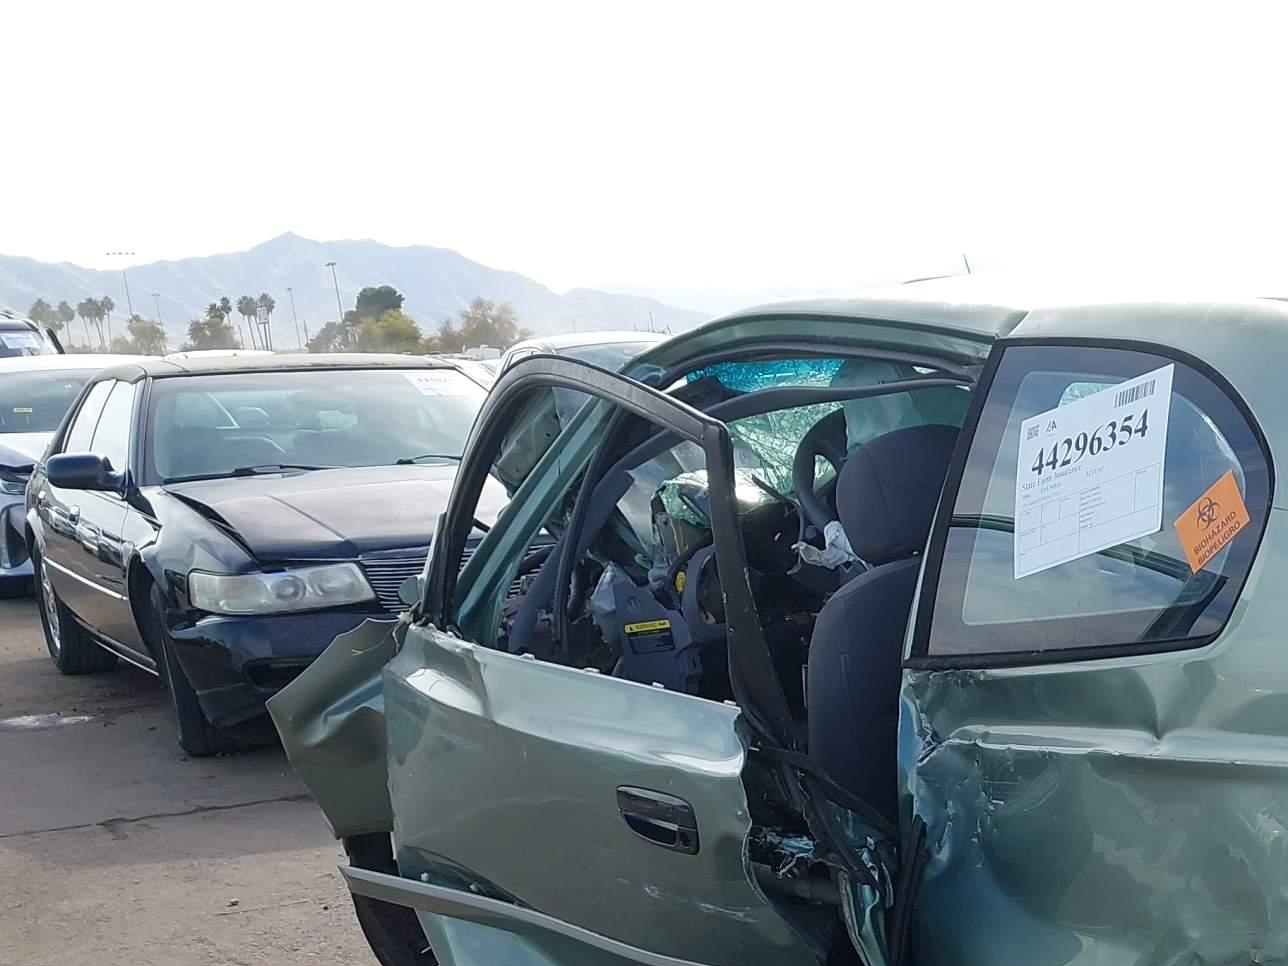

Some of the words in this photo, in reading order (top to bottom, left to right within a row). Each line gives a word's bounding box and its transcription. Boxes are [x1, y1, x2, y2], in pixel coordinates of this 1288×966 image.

[1031, 408, 1148, 475] 44296354
[1193, 511, 1237, 555] BIOHAZARD
[1197, 520, 1241, 565] BIOPELIGRO
